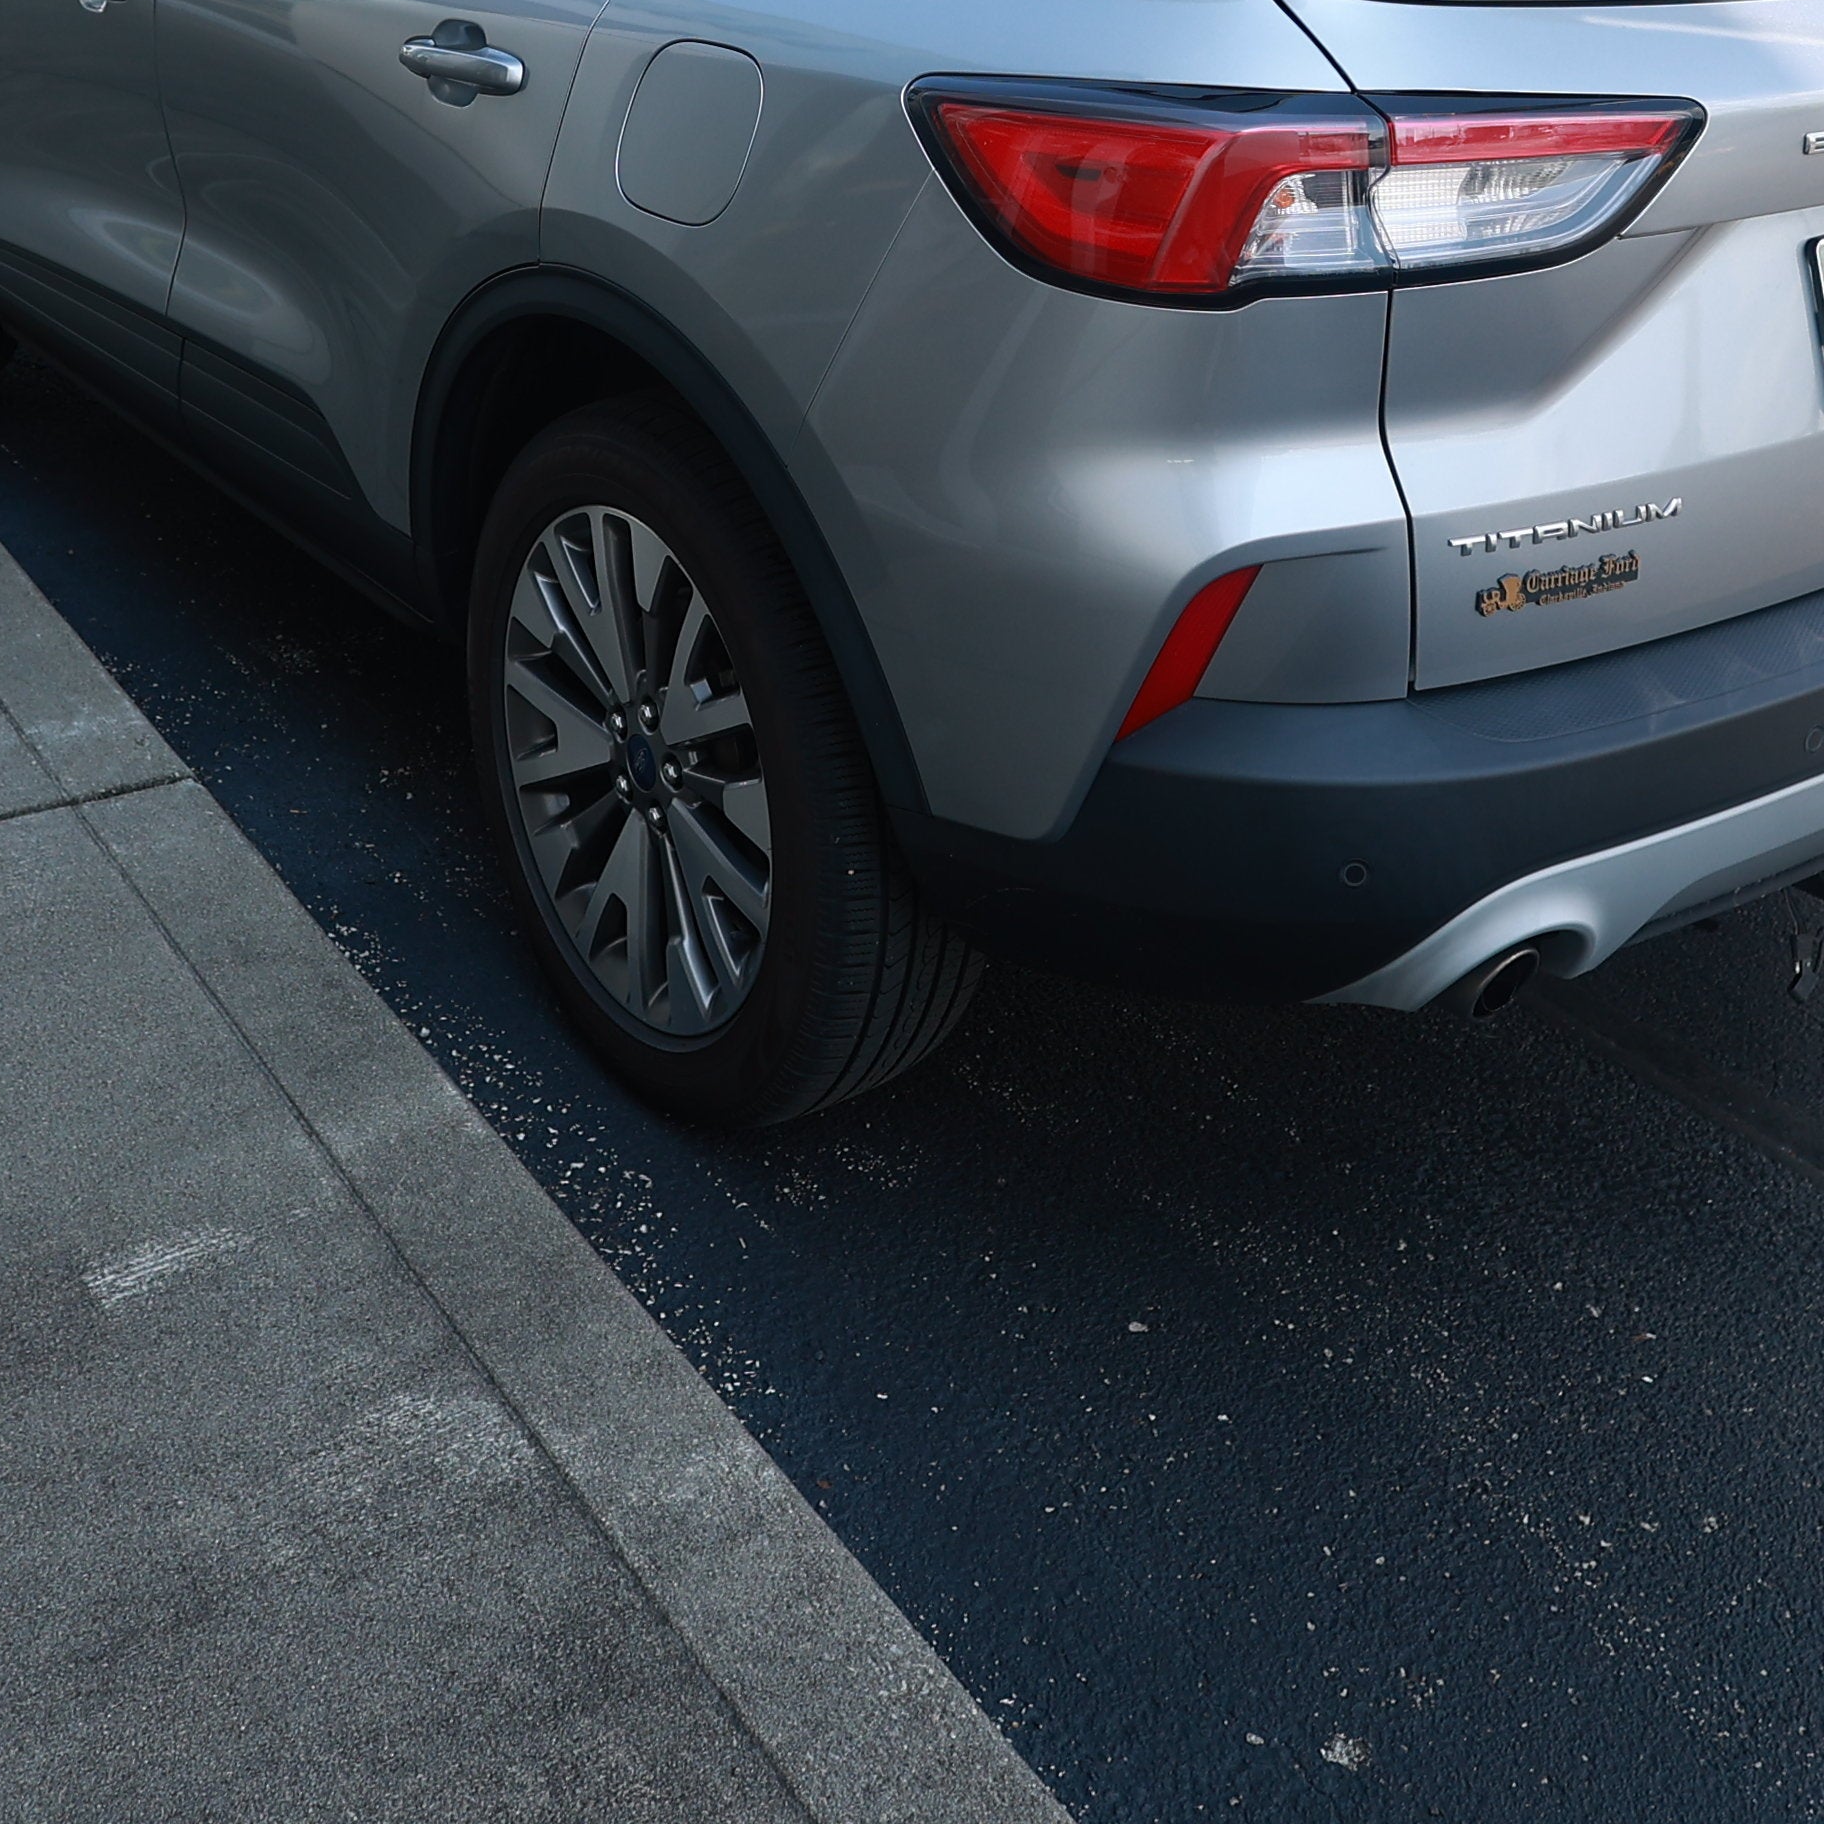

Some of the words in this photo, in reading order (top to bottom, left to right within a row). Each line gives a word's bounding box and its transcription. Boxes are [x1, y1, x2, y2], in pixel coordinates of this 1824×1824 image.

[1447, 497, 1683, 557] TITANIUM
[1525, 564, 1597, 594] Carriage
[1599, 551, 1642, 579] Ford
